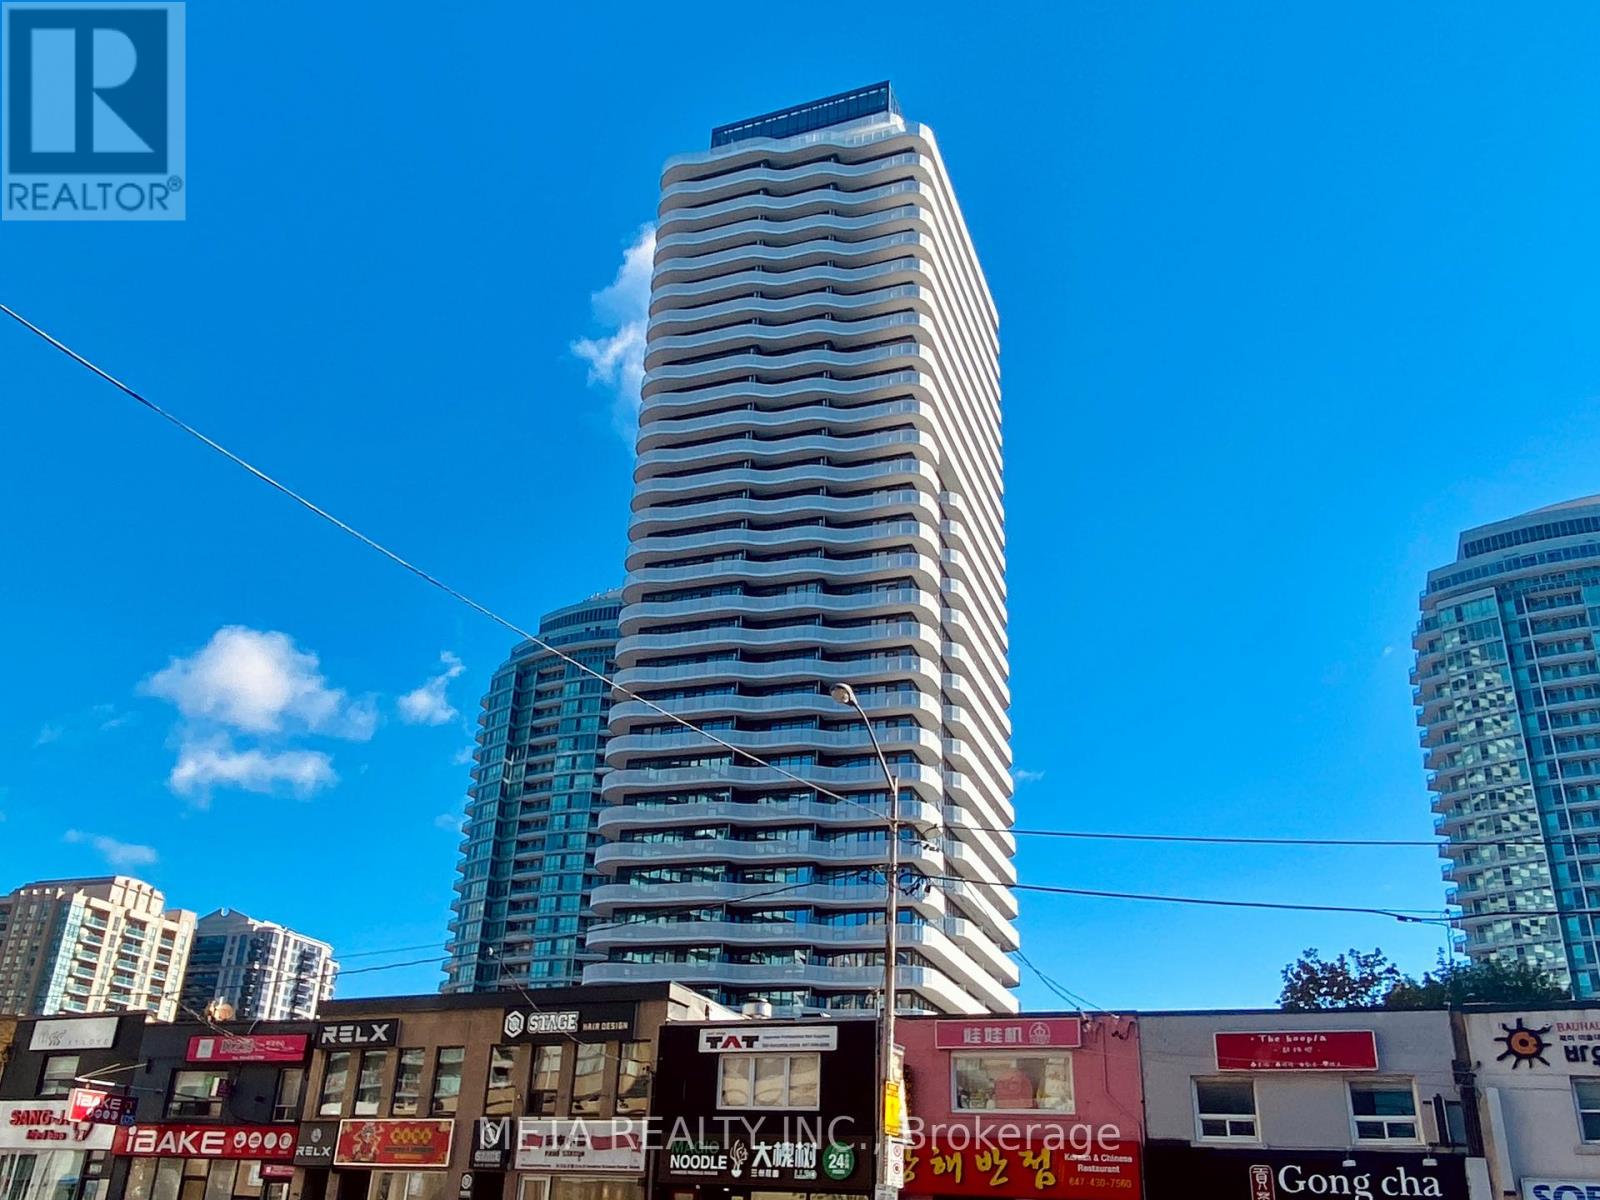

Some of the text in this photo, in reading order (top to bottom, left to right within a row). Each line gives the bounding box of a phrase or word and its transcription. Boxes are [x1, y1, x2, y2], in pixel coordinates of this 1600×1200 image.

[527, 1011, 629, 1033] STAGE HAIR DESIGN
[321, 1023, 390, 1043] RELX
[963, 1027, 1022, 1043] 娃娃机
[706, 1035, 759, 1048] TAT
[126, 1125, 226, 1154] iBAKE
[296, 1146, 331, 1157] RELX
[1101, 1154, 1133, 1163] Chinese
[670, 1154, 727, 1169] NOODLE
[828, 1154, 845, 1169] 24
[1077, 1164, 1120, 1173] Restaurant
[1278, 1165, 1443, 1200] Gong cha
